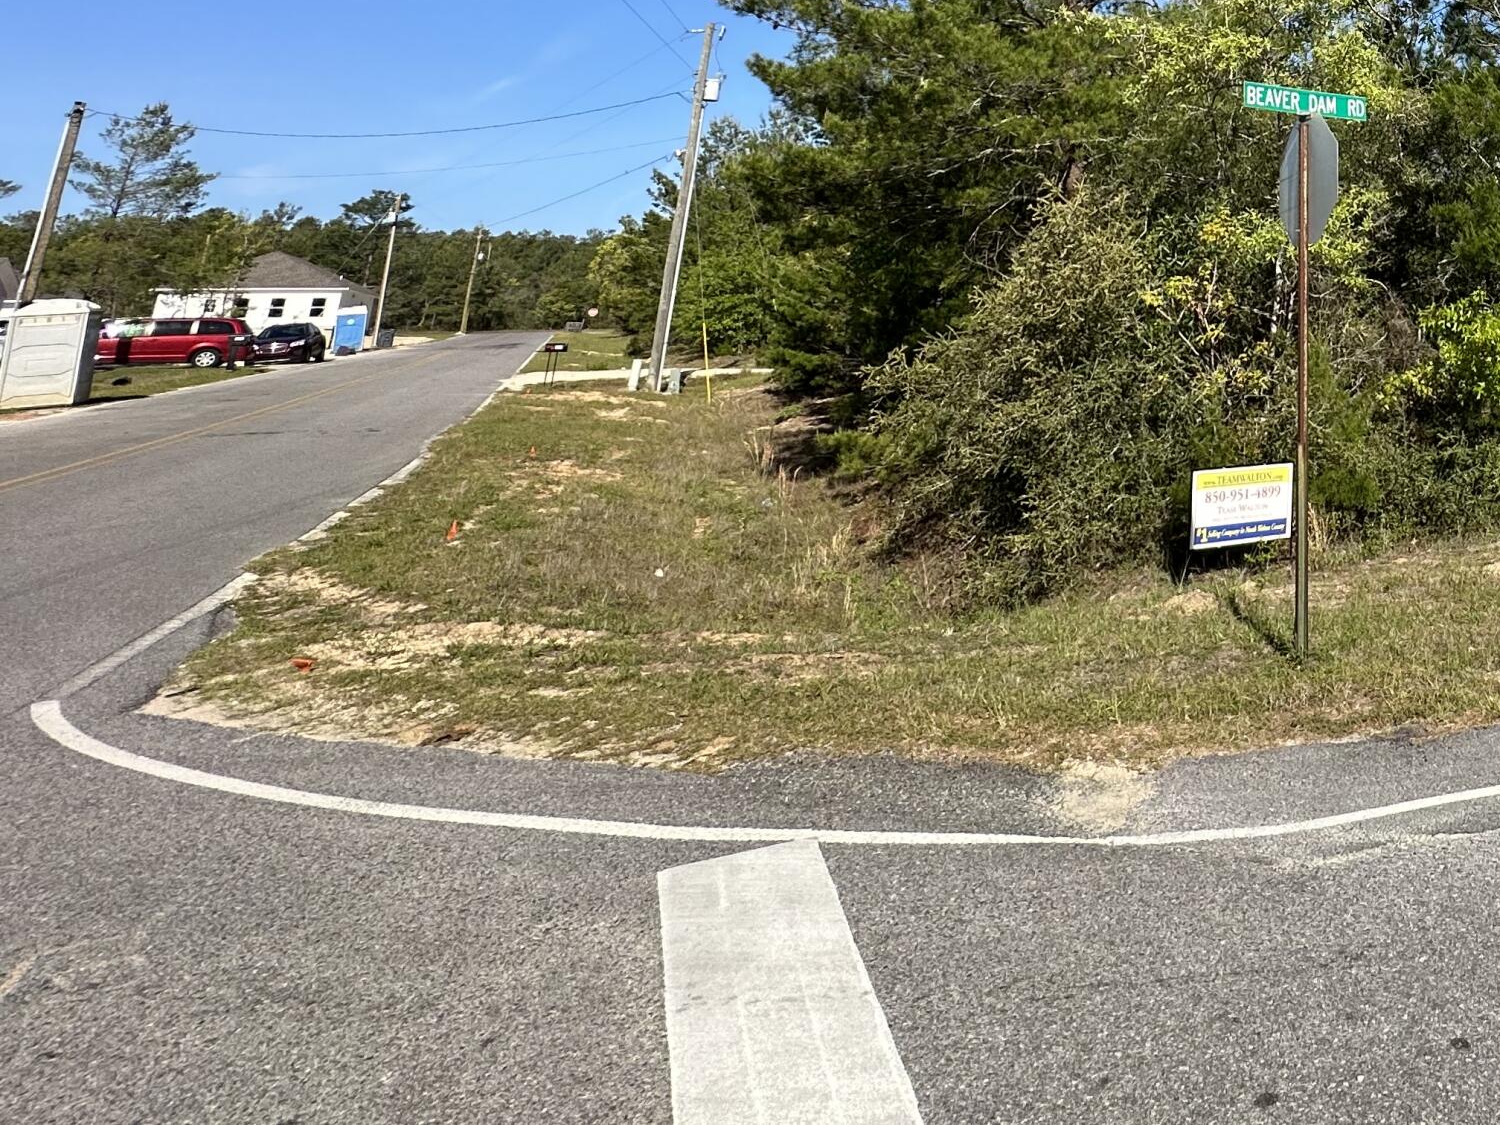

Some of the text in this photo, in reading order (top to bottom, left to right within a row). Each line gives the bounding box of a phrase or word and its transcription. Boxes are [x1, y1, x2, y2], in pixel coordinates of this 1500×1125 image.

[1246, 85, 1365, 117] BEAVER DAM RD
[1205, 485, 1281, 504] 850-951-4899
